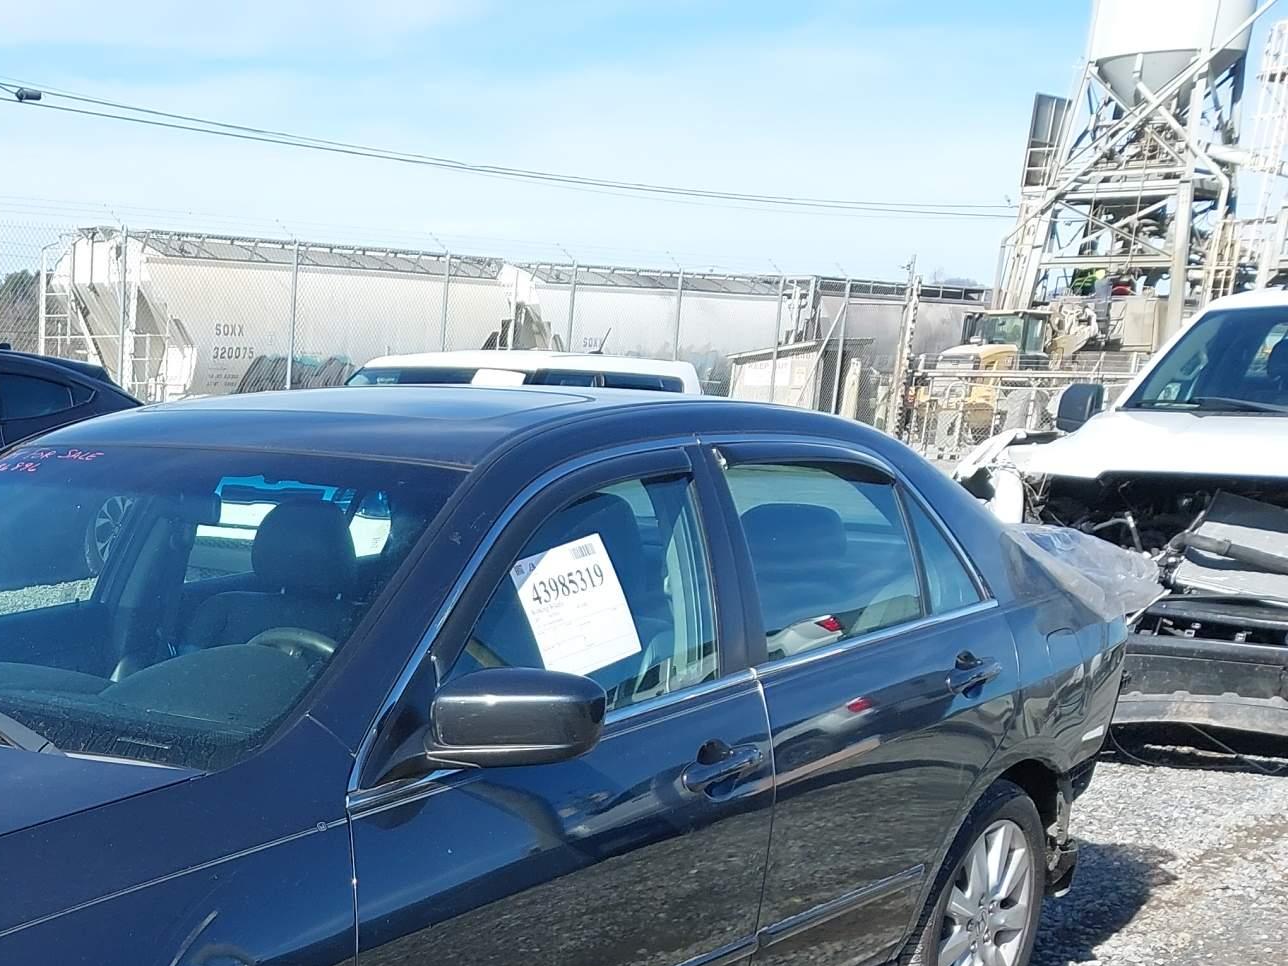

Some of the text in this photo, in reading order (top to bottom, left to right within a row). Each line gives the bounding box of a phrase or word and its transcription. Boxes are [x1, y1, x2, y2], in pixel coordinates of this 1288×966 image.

[212, 346, 255, 360] 320075
[57, 449, 105, 461] SALE
[532, 563, 605, 606] 43985319
